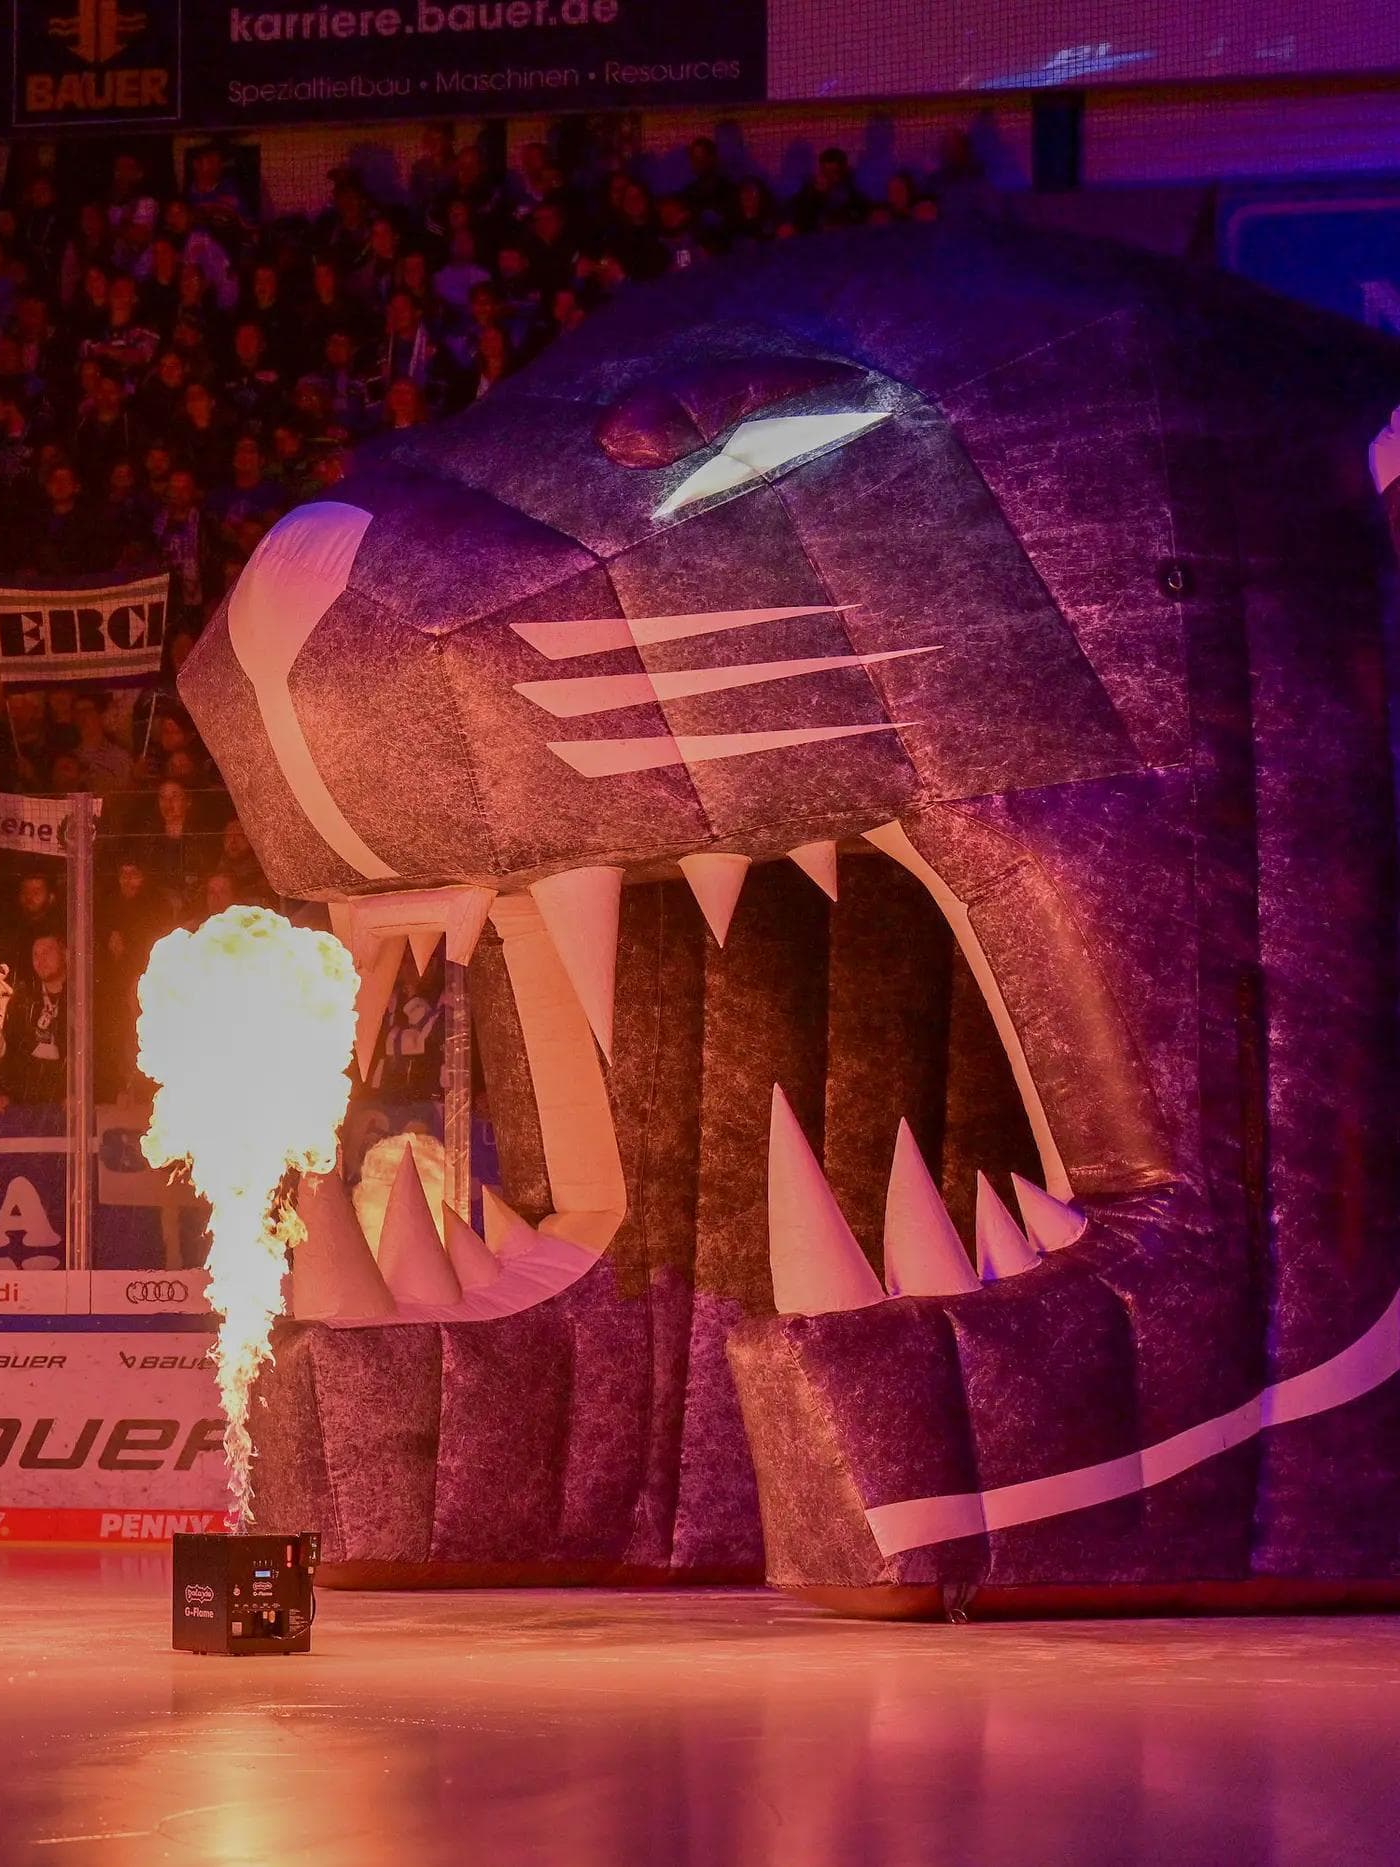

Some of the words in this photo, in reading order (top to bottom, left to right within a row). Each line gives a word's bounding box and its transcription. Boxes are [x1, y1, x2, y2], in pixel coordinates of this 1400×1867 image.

[230, 0, 619, 43] karriere.bauer.de
[25, 67, 170, 112] BAUER
[228, 75, 411, 104] Spezialtiefbau
[435, 64, 581, 94] Maschinen
[604, 55, 742, 84] Resources
[184, 1606, 214, 1619] G-Flame
